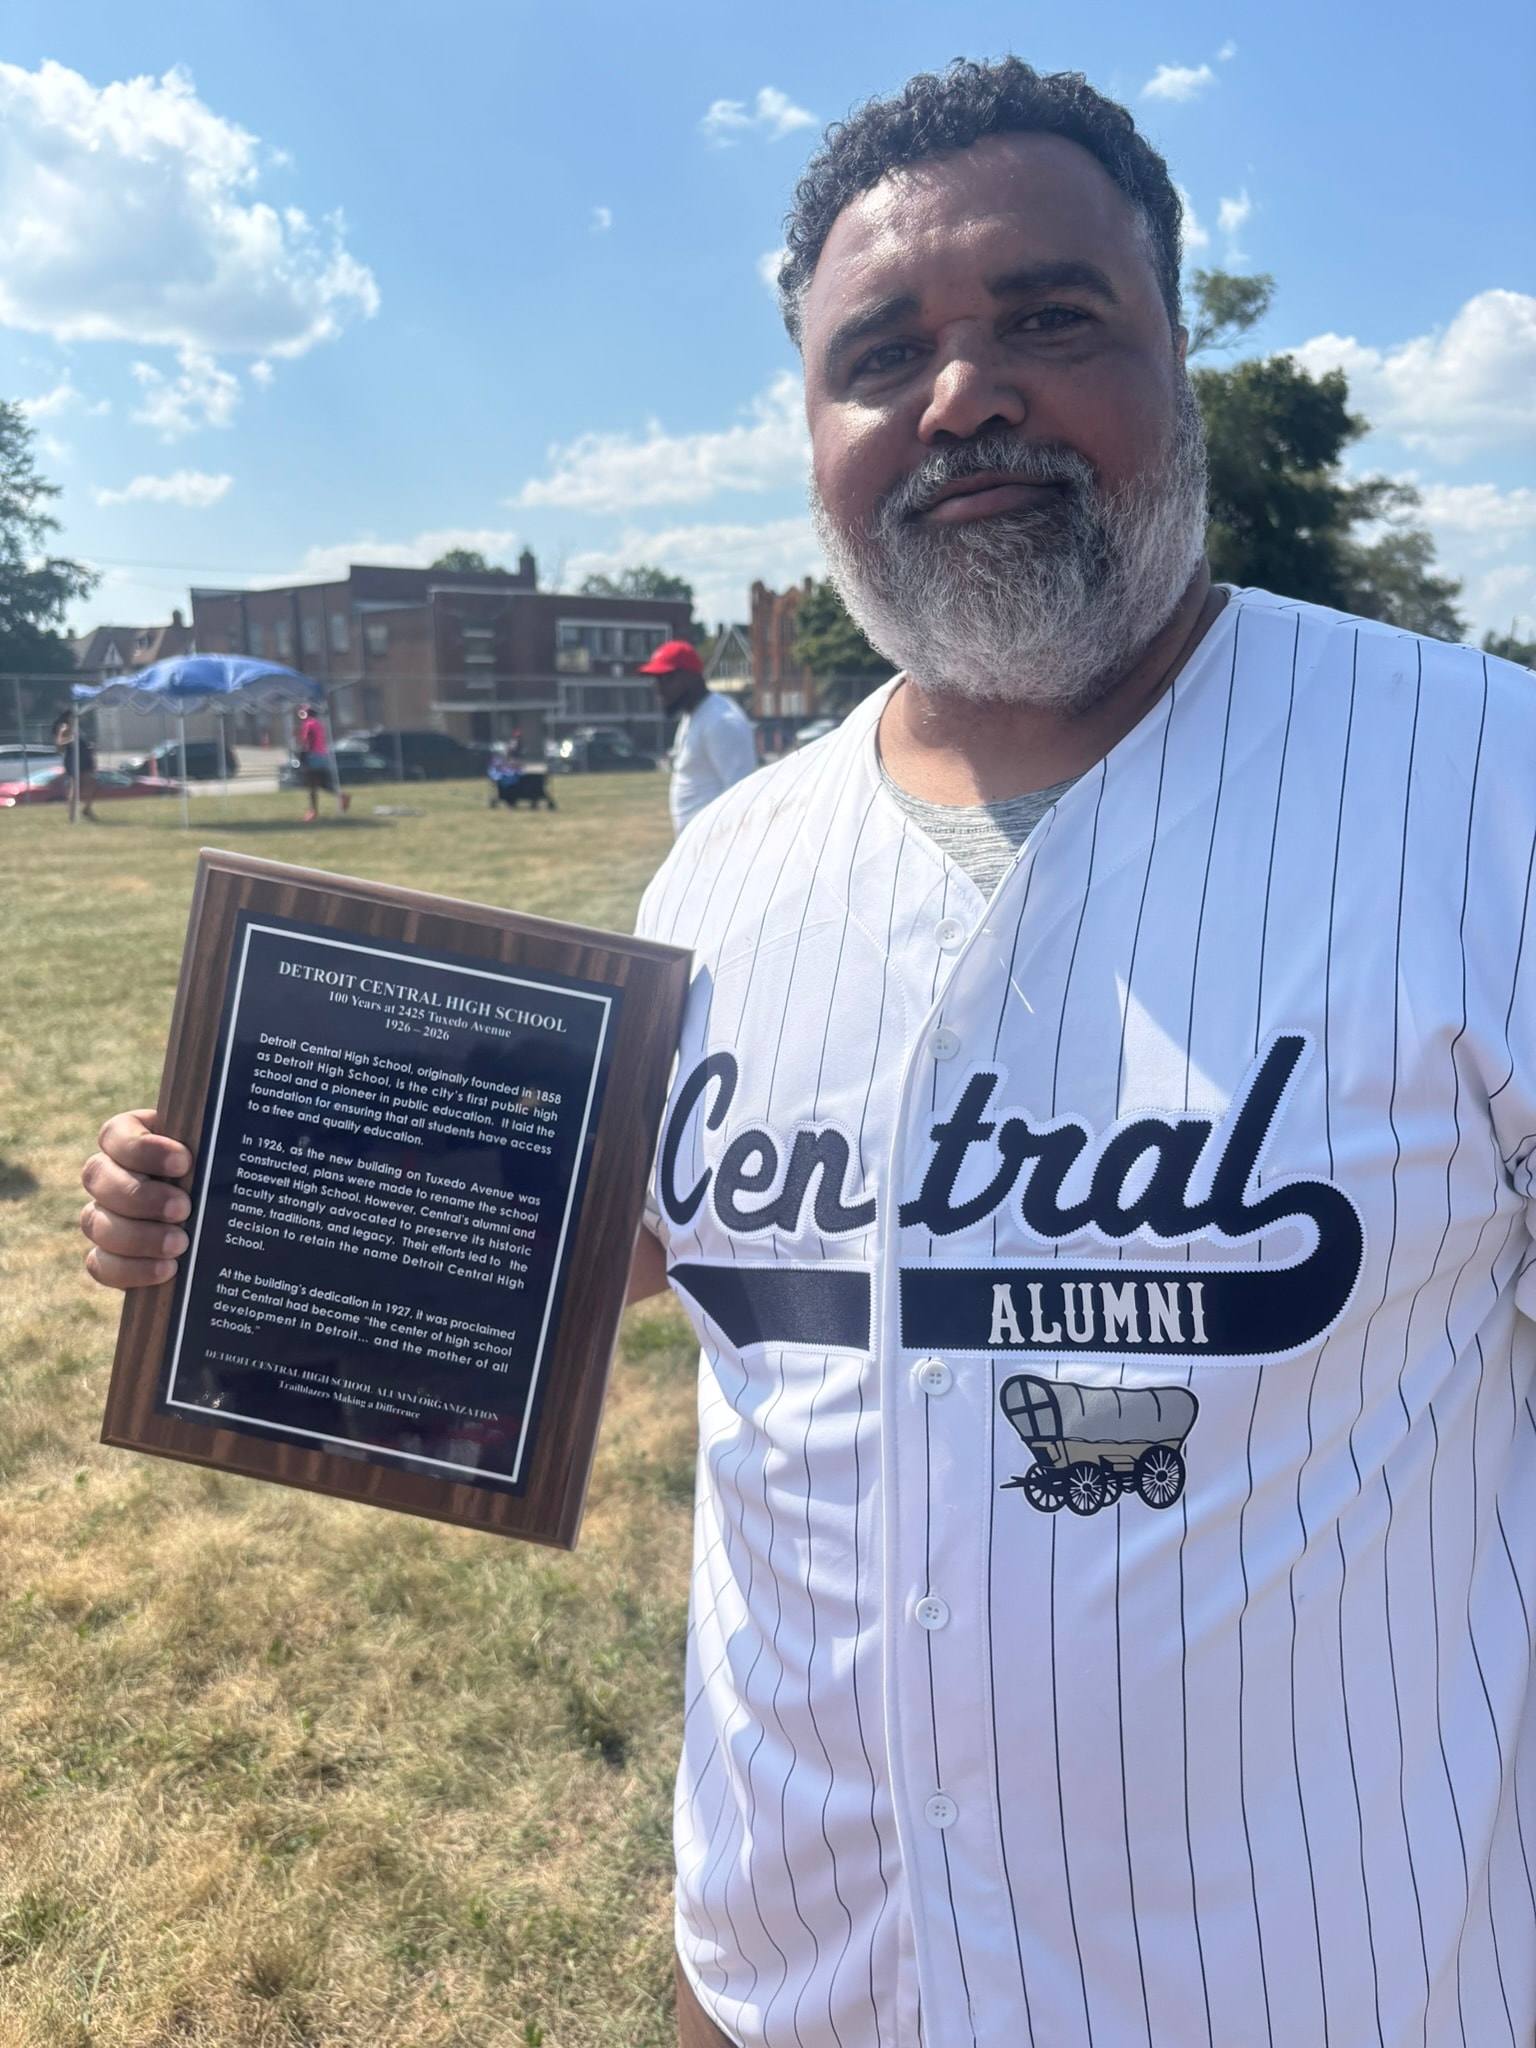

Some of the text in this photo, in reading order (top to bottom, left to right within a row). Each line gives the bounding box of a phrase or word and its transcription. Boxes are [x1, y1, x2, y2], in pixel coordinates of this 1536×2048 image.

[279, 961, 567, 1033] DETROIT CENTRAL HIGH SCHOOL
[329, 990, 512, 1038] 100 Years at 2425 Tuxedo Avenue
[385, 1018, 411, 1033] 1926
[423, 1025, 450, 1041] 2026
[253, 1068, 556, 1139] school and a pioneer in public education. It laid the
[256, 1051, 271, 1062] as
[273, 1052, 314, 1071] Detroit
[316, 1061, 345, 1078] High
[347, 1068, 392, 1088] School,
[395, 1077, 406, 1090] is
[408, 1080, 429, 1095] the
[466, 1092, 489, 1107] first
[490, 1100, 529, 1116] public
[533, 1107, 558, 1123] high
[259, 1032, 562, 1105] Detroit Central High School, originally founded in 1858
[247, 1099, 424, 1146] to a free and quality education.
[250, 1082, 552, 1155] foundation for ensuring that all students have access
[659, 1034, 1310, 1241] Central
[236, 1167, 291, 1188] Roosevelt
[292, 1178, 318, 1195] High
[320, 1184, 361, 1203] School.
[364, 1193, 417, 1216] However,
[471, 1218, 511, 1235] alumni
[512, 1227, 537, 1240] and
[239, 1152, 539, 1223] constructed, plans were made to rename the school
[242, 1133, 541, 1206] In 1926, as the new building on Tuxedo Avenue was
[224, 1232, 265, 1251] School.
[227, 1217, 525, 1290] decision to retain the name Detroit Central High
[230, 1202, 529, 1273] name, traditions, and legacy. Their efforts led to the
[233, 1183, 532, 1257] faculty strongly advocated to preserve its historic
[213, 1300, 509, 1374] development in Detroit... and the mother of all
[216, 1283, 239, 1297] that
[241, 1288, 284, 1307] Central
[285, 1298, 310, 1313] had
[311, 1303, 361, 1324] become
[390, 1323, 429, 1339] center
[430, 1331, 444, 1342] of
[444, 1332, 471, 1349] high
[472, 1341, 513, 1357] school
[218, 1267, 232, 1279] At
[233, 1269, 252, 1284] the
[308, 1287, 370, 1309] dedication
[371, 1299, 382, 1312] in
[386, 1302, 413, 1320] 1927,
[415, 1309, 424, 1321] it
[425, 1313, 448, 1326] was
[449, 1319, 516, 1341] proclaimed
[987, 1281, 1210, 1344] ALUMNI
[251, 1359, 300, 1377] CENTRAL
[301, 1370, 329, 1384] HIGH
[330, 1376, 373, 1393] SCHOOL
[279, 1380, 421, 1419] Trailblazers Making a Difference
